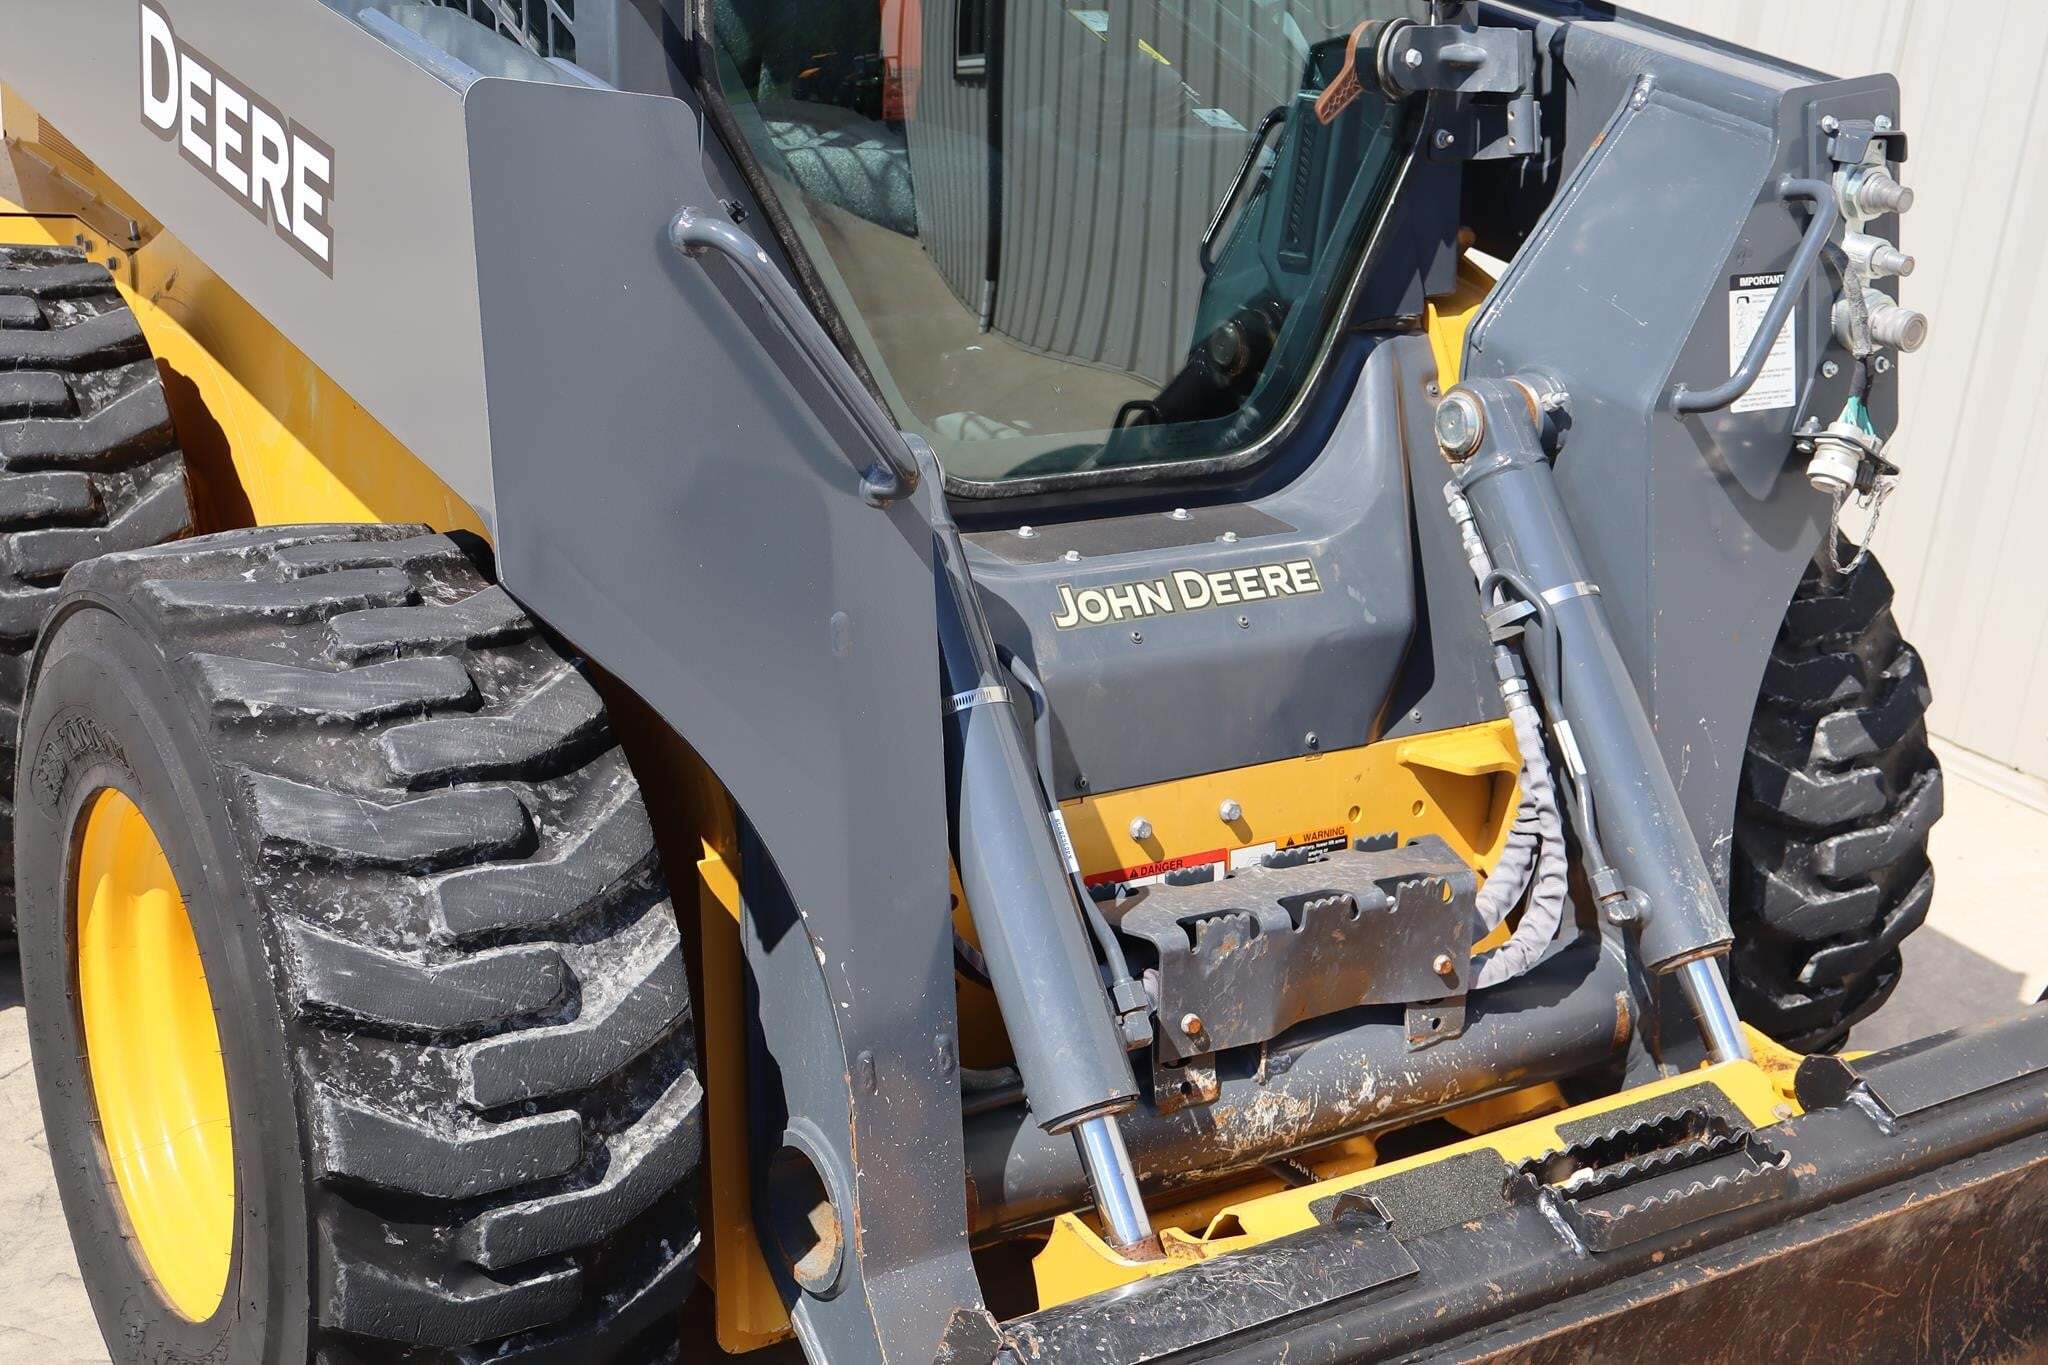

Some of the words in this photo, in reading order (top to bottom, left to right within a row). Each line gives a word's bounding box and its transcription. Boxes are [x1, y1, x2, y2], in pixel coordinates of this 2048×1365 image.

[141, 3, 330, 264] DEERE
[1739, 274, 1785, 287] IMPORTANT
[1053, 580, 1175, 629] JOHN
[1170, 560, 1321, 610] DEERE
[1303, 826, 1345, 843] WARNING
[1140, 859, 1183, 876] DANGER
